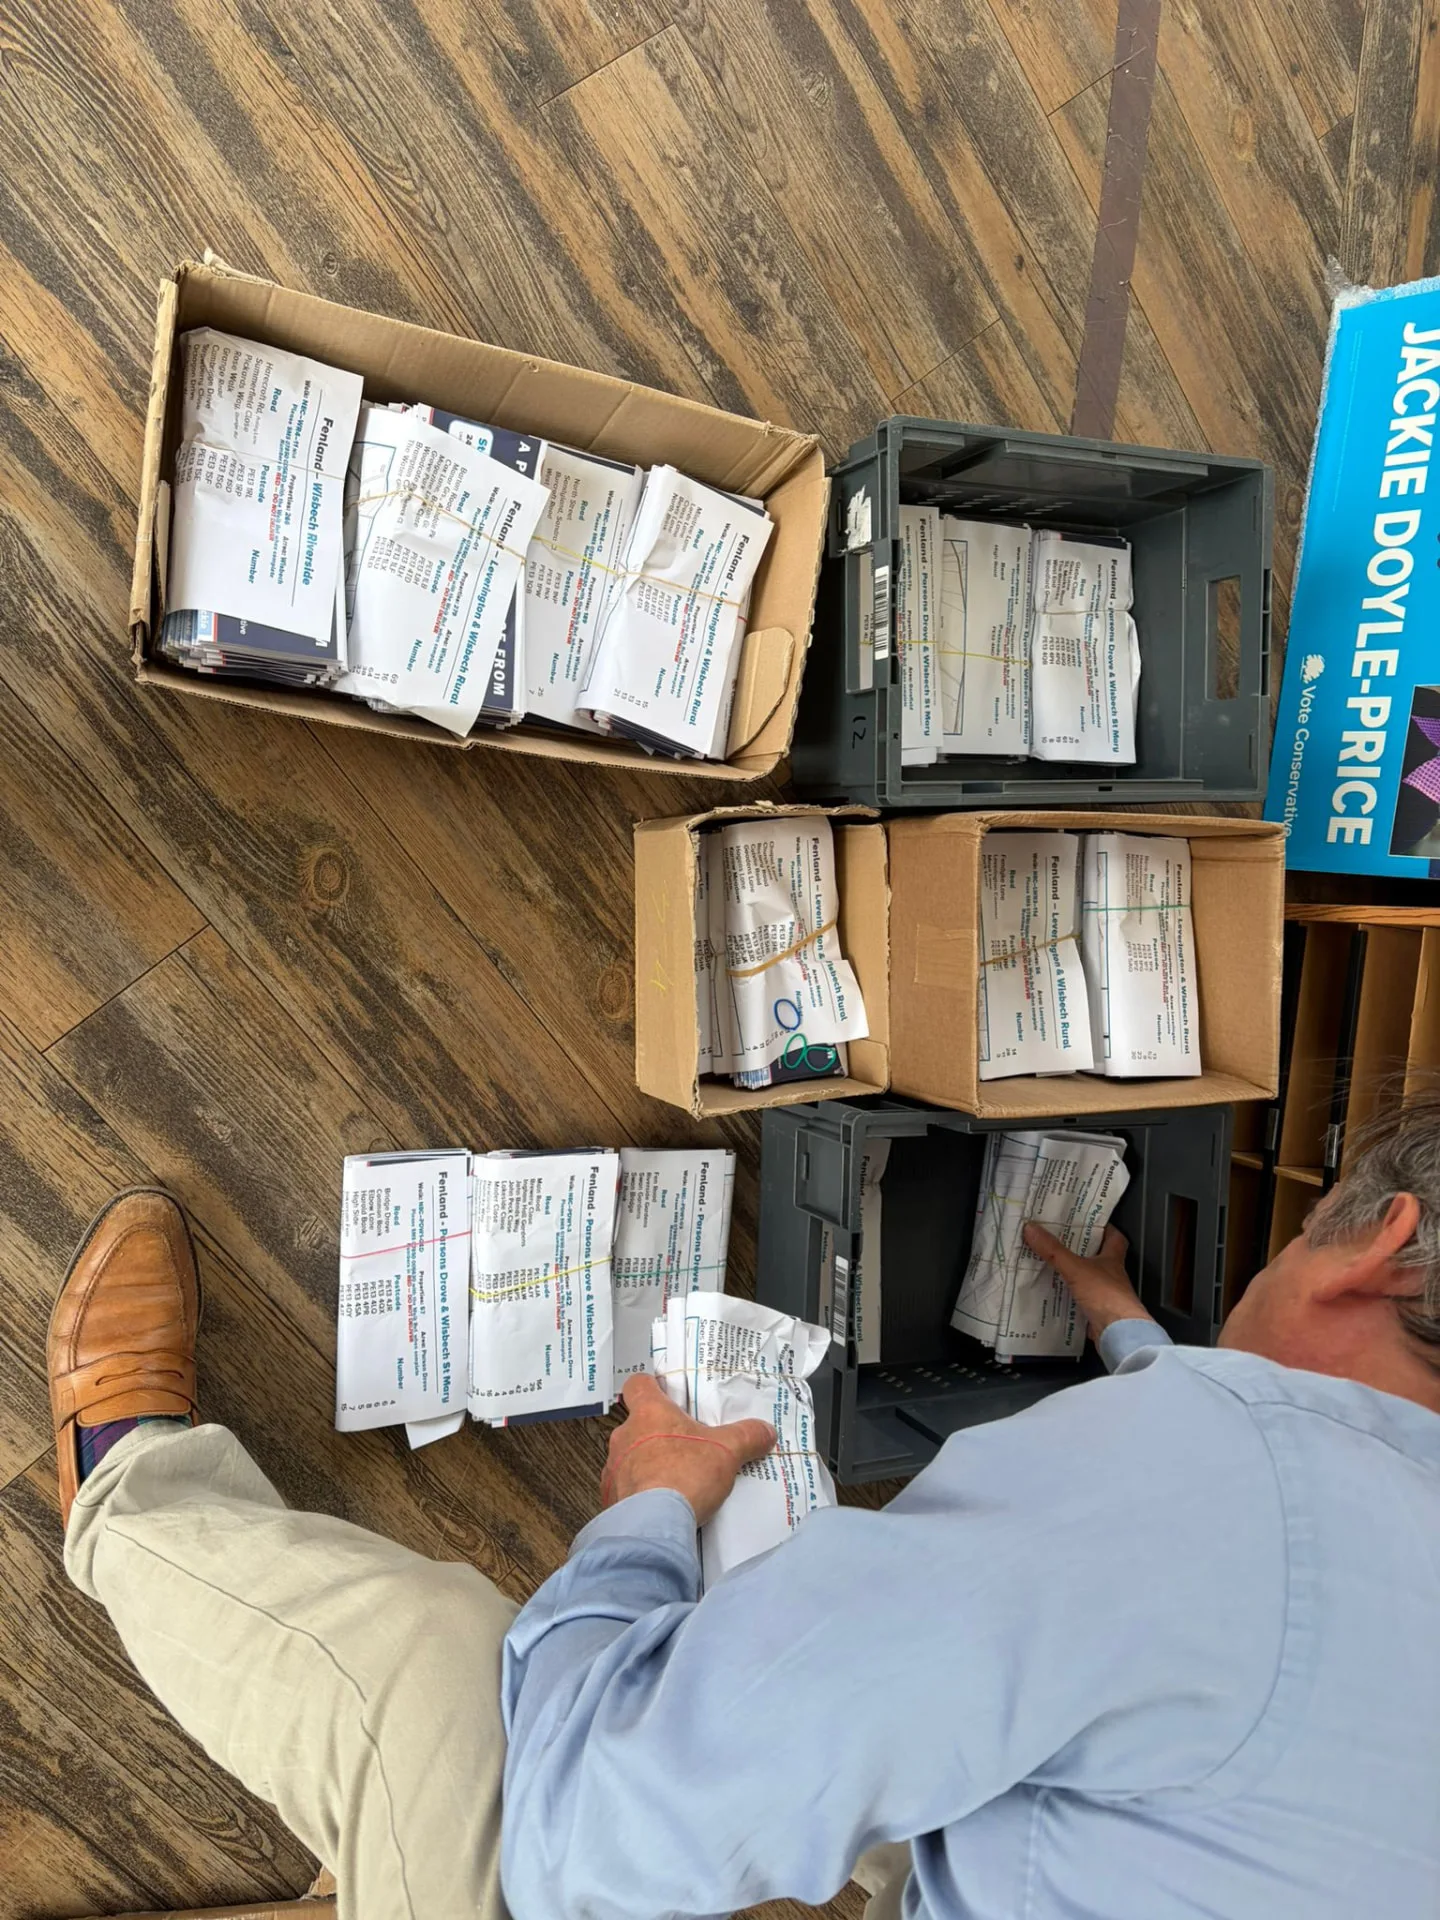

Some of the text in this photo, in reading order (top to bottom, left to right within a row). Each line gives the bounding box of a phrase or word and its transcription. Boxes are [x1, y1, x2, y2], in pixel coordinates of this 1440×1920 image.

[226, 350, 241, 392] Rose Walk
[238, 353, 252, 389] Pickards
[245, 357, 263, 409] Summerfield
[242, 409, 253, 432] Close
[1379, 322, 1440, 498] JACKIE
[246, 468, 256, 486] PE13
[247, 387, 281, 583] Road Postcode Number
[445, 466, 468, 512] Barton Road
[566, 477, 580, 520] North Street
[300, 416, 333, 585] Fenland Wisbech Riverside
[276, 474, 296, 584] Properties: Wisbech
[918, 518, 927, 563] Fenland
[406, 490, 470, 672] Road Postcode Number
[548, 500, 588, 684] Road Postcode Number
[920, 572, 928, 612] Parsons
[1109, 559, 1117, 599] Fenland
[449, 499, 521, 705] Fenland Leverington & Wisbech Rural
[652, 528, 704, 697] Road Postcode Number
[687, 533, 750, 726] Fenland Leverington & Wisbech Rural
[921, 614, 929, 641] Drove
[493, 648, 506, 696] FROM
[922, 655, 930, 695] Wisbech
[1326, 509, 1422, 845] DOYLE-PRICE
[924, 698, 930, 708] St
[1109, 679, 1117, 715] Wisbech
[922, 710, 931, 735] Mary
[1111, 730, 1119, 752] Mary
[1112, 718, 1118, 727] St
[1279, 682, 1317, 838] Vote Conservative
[1049, 855, 1061, 900] Fenland
[1175, 864, 1183, 907] Fenland
[807, 837, 823, 881] Fenland
[835, 994, 847, 1021] Rural
[1046, 912, 1062, 967] Leverington
[1176, 918, 1185, 974] Leverington
[1008, 869, 1024, 1041] Road Number
[1056, 978, 1067, 1019] Wisbech
[1060, 1021, 1070, 1048] Rural
[351, 1191, 359, 1206] High
[438, 1172, 447, 1218] Fenland
[587, 1166, 598, 1209] Fenland
[697, 1161, 708, 1205] Fenland
[1084, 1159, 1119, 1236] Fenland Parsons
[438, 1229, 447, 1269] Parsons
[584, 1219, 593, 1258] Parsons
[694, 1214, 704, 1251] Parsons
[439, 1272, 448, 1302] Drove
[691, 1254, 701, 1283] Drove
[585, 1304, 594, 1347] Wisbech
[854, 1273, 863, 1341] Wisbech Rural
[440, 1315, 449, 1358] Wisbech
[586, 1350, 594, 1361] St
[696, 1341, 708, 1364] Lane
[441, 1376, 450, 1402] Mary
[442, 1362, 450, 1373] St
[586, 1364, 596, 1391] Mary
[797, 1414, 817, 1500] Leverington &
